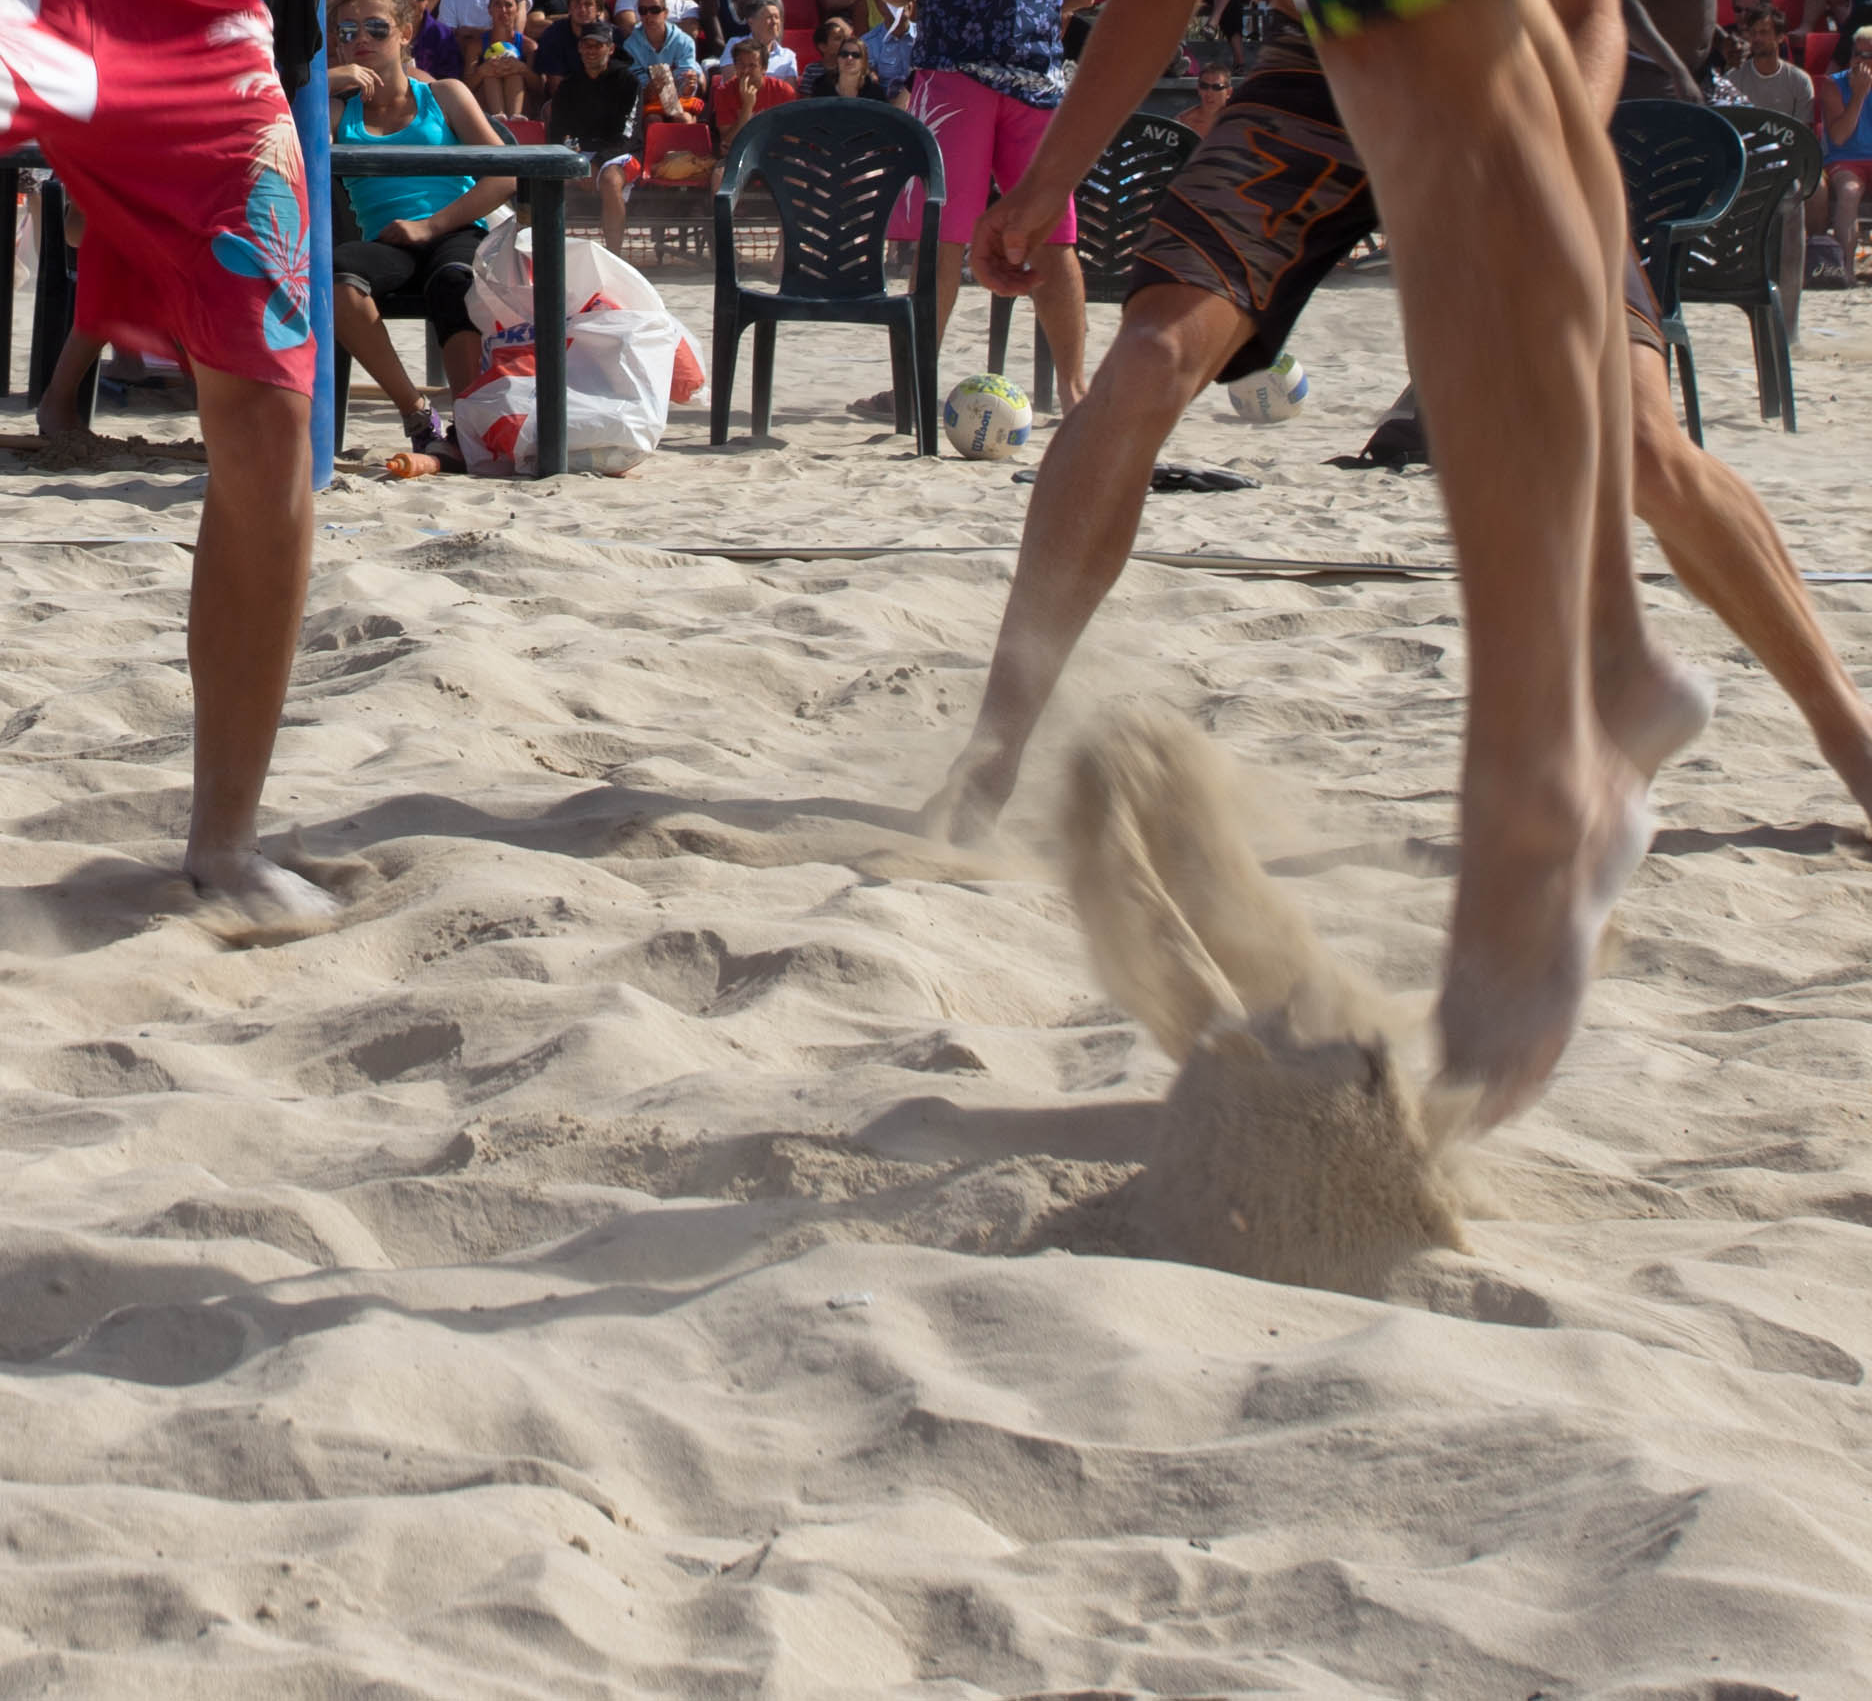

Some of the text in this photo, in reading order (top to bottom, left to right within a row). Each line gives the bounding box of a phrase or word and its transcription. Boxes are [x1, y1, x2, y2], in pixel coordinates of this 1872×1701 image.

[1141, 123, 1179, 146] AVB
[1759, 120, 1794, 145] AVB
[971, 410, 993, 452] Wilson
